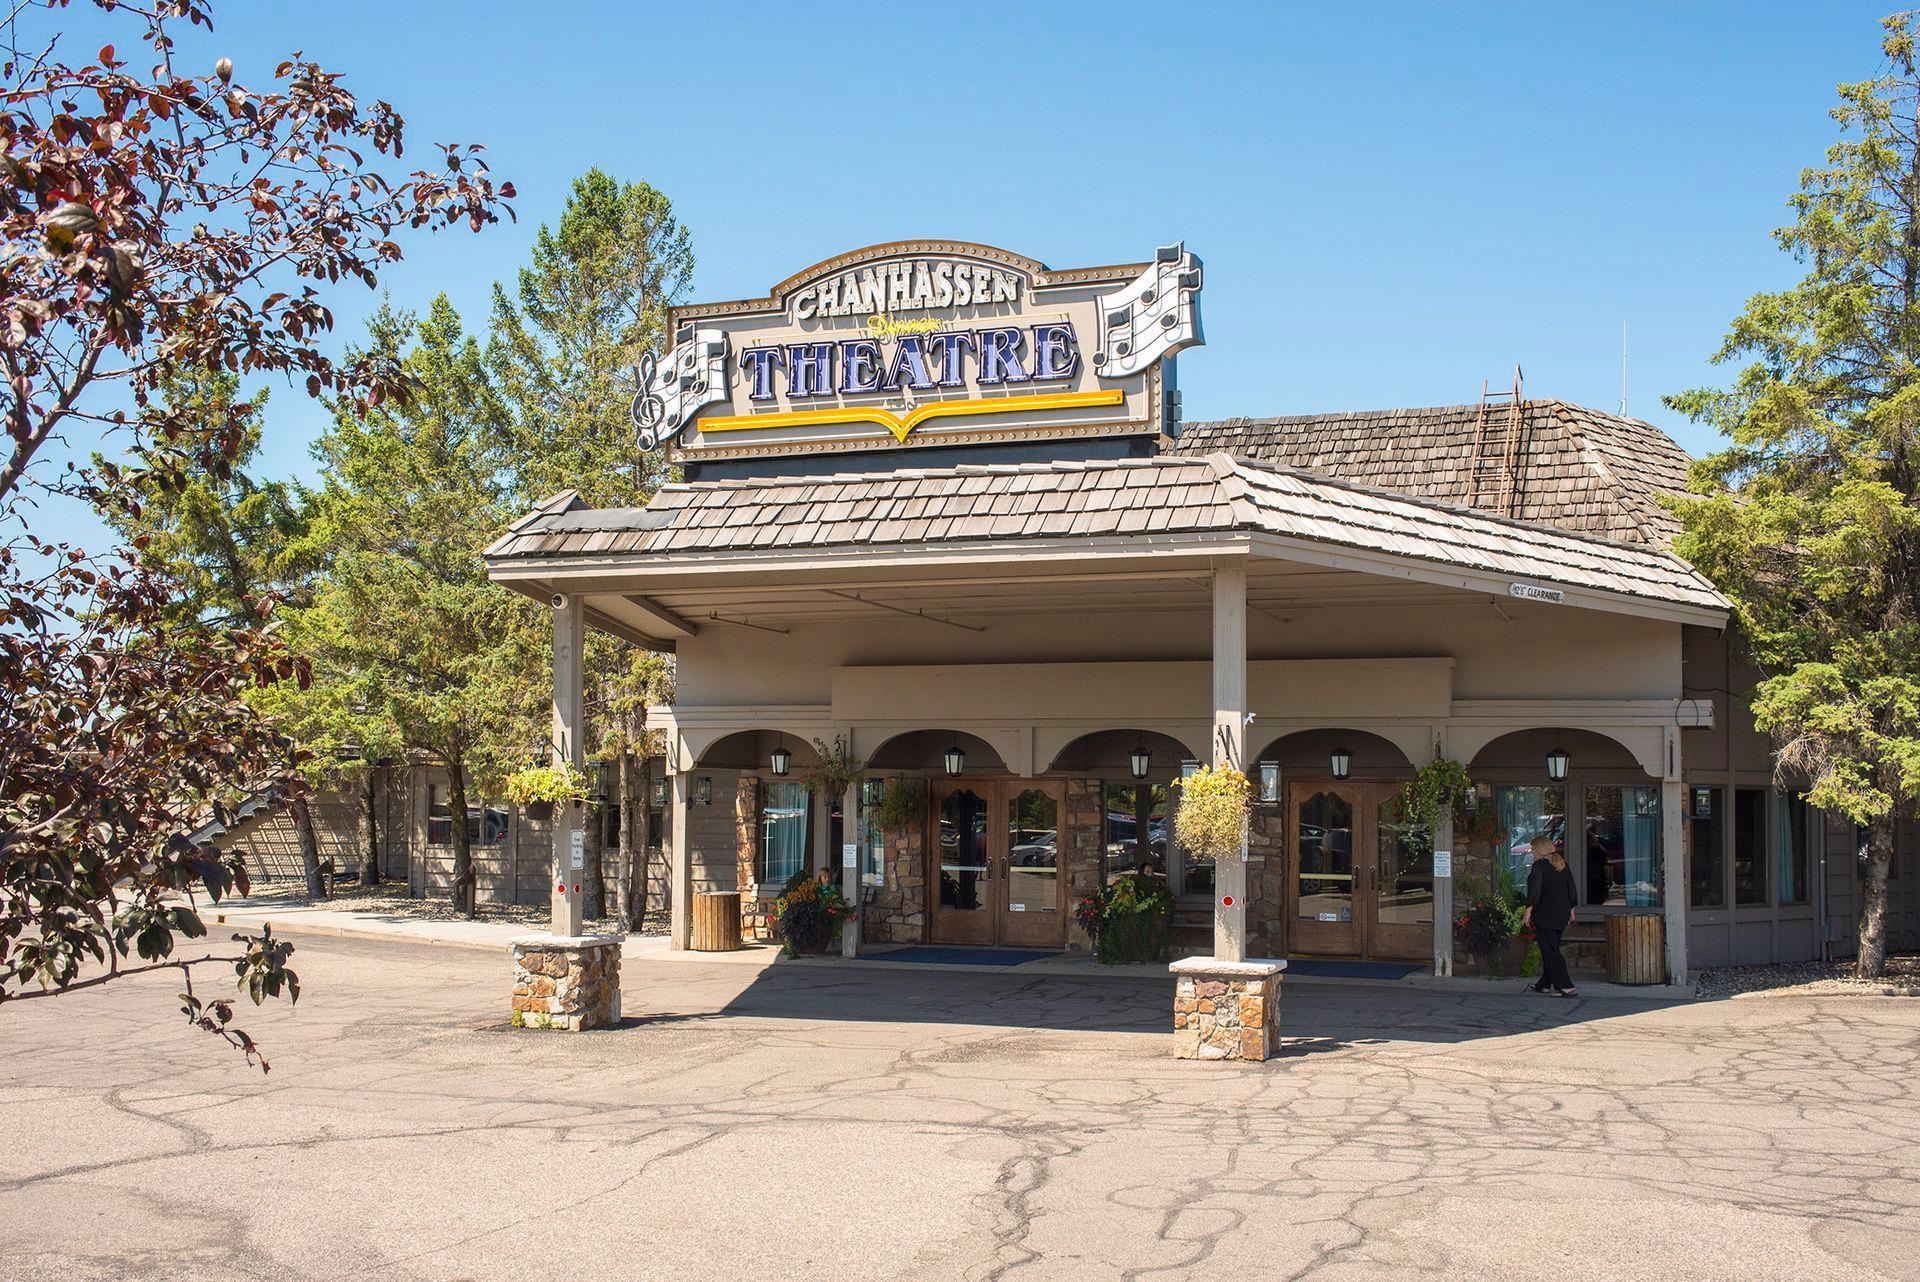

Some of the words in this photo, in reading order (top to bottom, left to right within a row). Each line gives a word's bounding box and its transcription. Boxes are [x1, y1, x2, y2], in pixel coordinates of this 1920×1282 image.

[792, 261, 1018, 320] CHANHASSEN
[740, 322, 1079, 400] THEATRE
[1527, 587, 1561, 601] CLEARANCE
